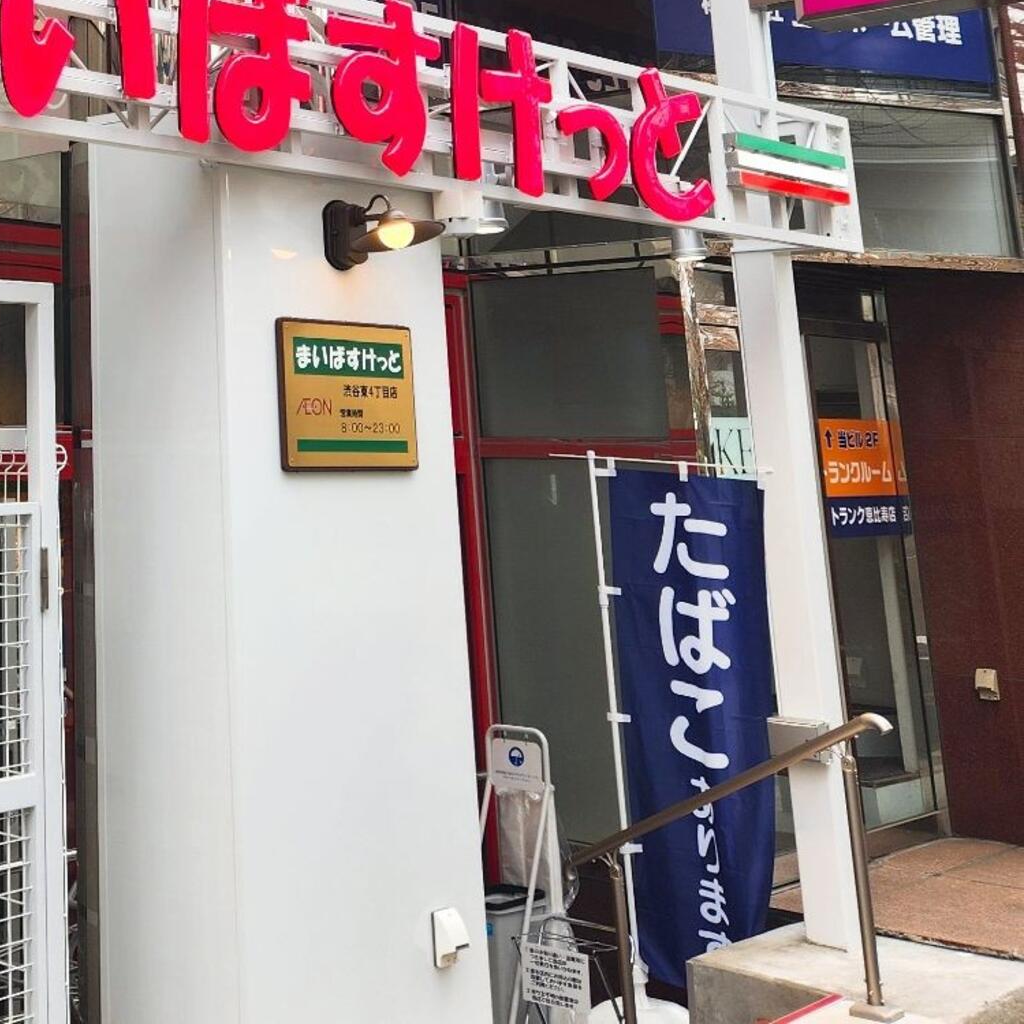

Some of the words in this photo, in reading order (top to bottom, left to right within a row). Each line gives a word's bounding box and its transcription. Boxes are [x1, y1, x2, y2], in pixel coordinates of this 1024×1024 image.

[295, 344, 402, 373] まいばすけっと
[343, 384, 399, 399] 渋谷東4丁目店
[823, 460, 894, 484] ランクルーム
[830, 505, 897, 526] トランク恵比寿店
[649, 491, 735, 772] たばこ
